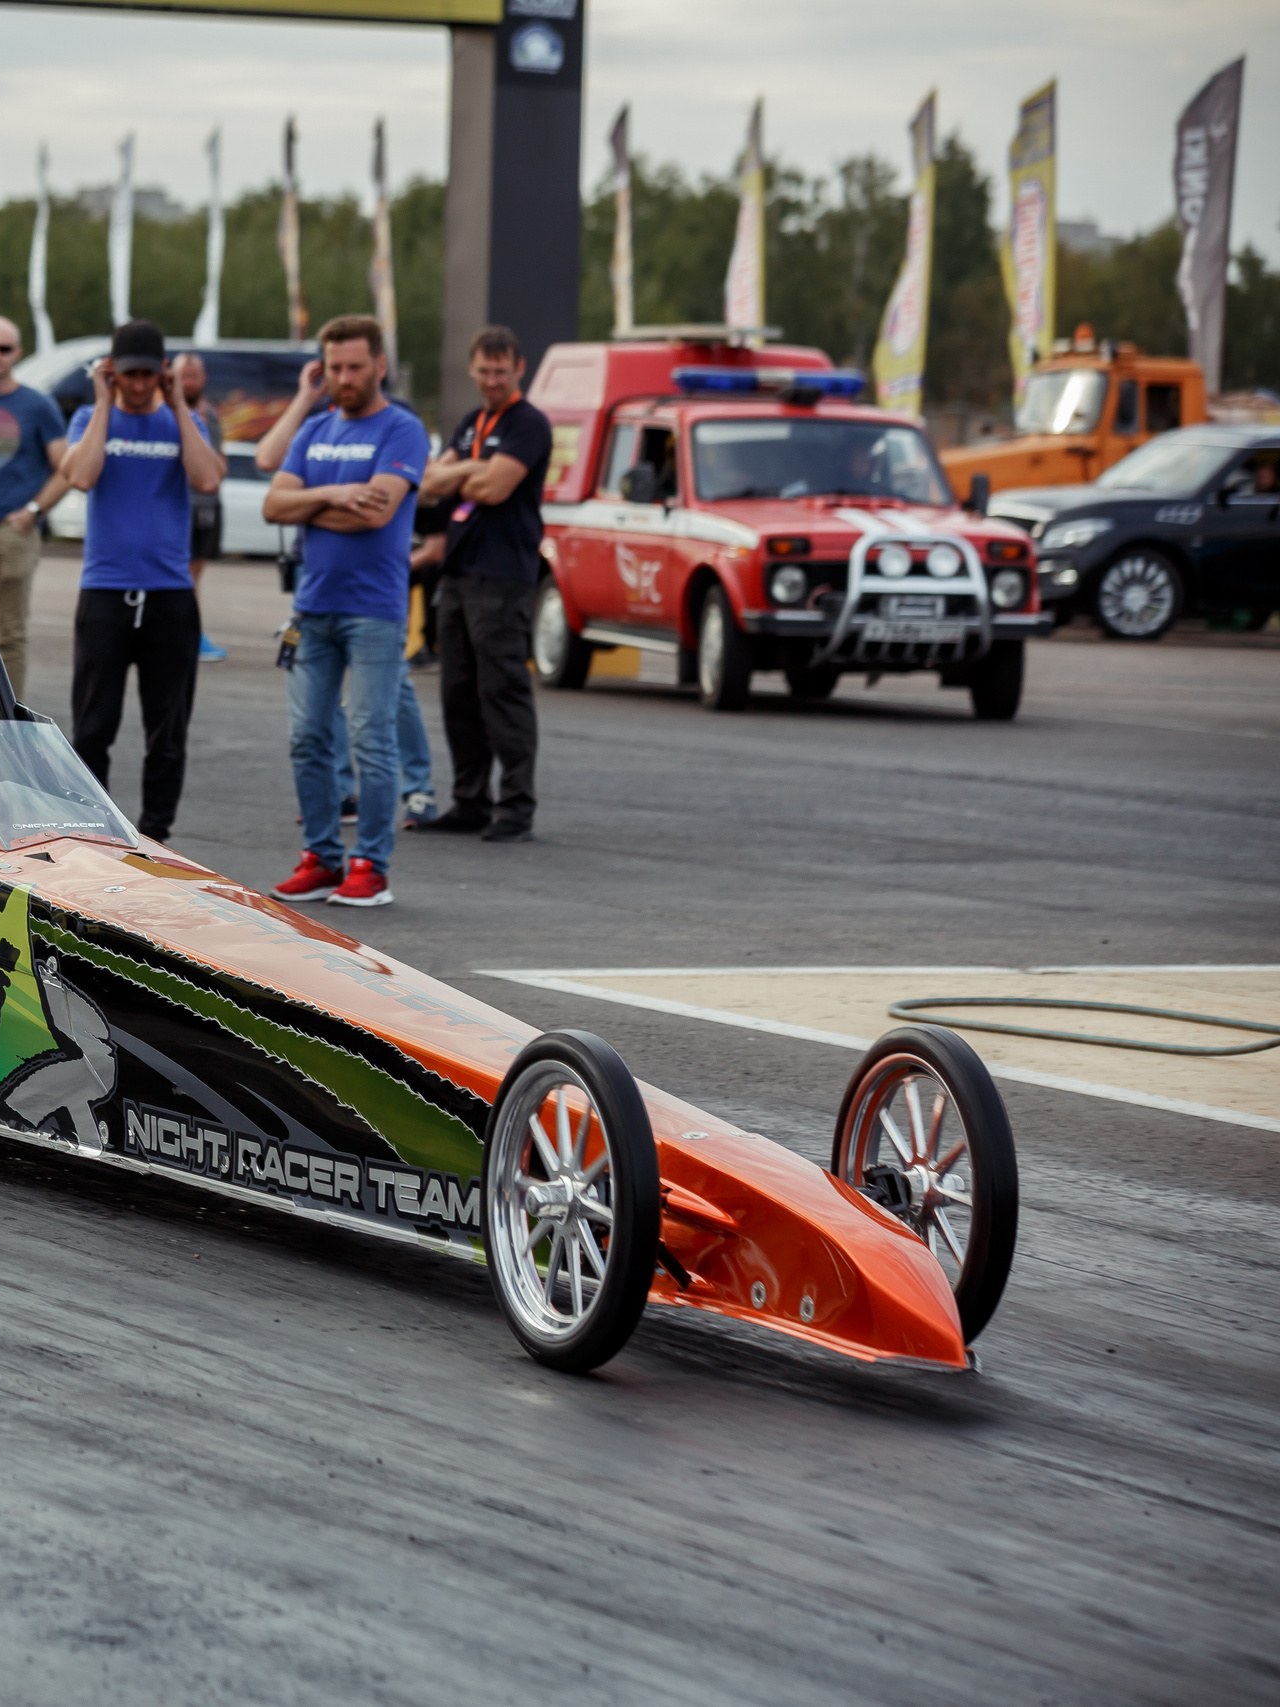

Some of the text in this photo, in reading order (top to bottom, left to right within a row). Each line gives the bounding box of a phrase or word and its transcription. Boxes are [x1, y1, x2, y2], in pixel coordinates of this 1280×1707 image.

[126, 1108, 481, 1227] NIGHT RACER TEAM
